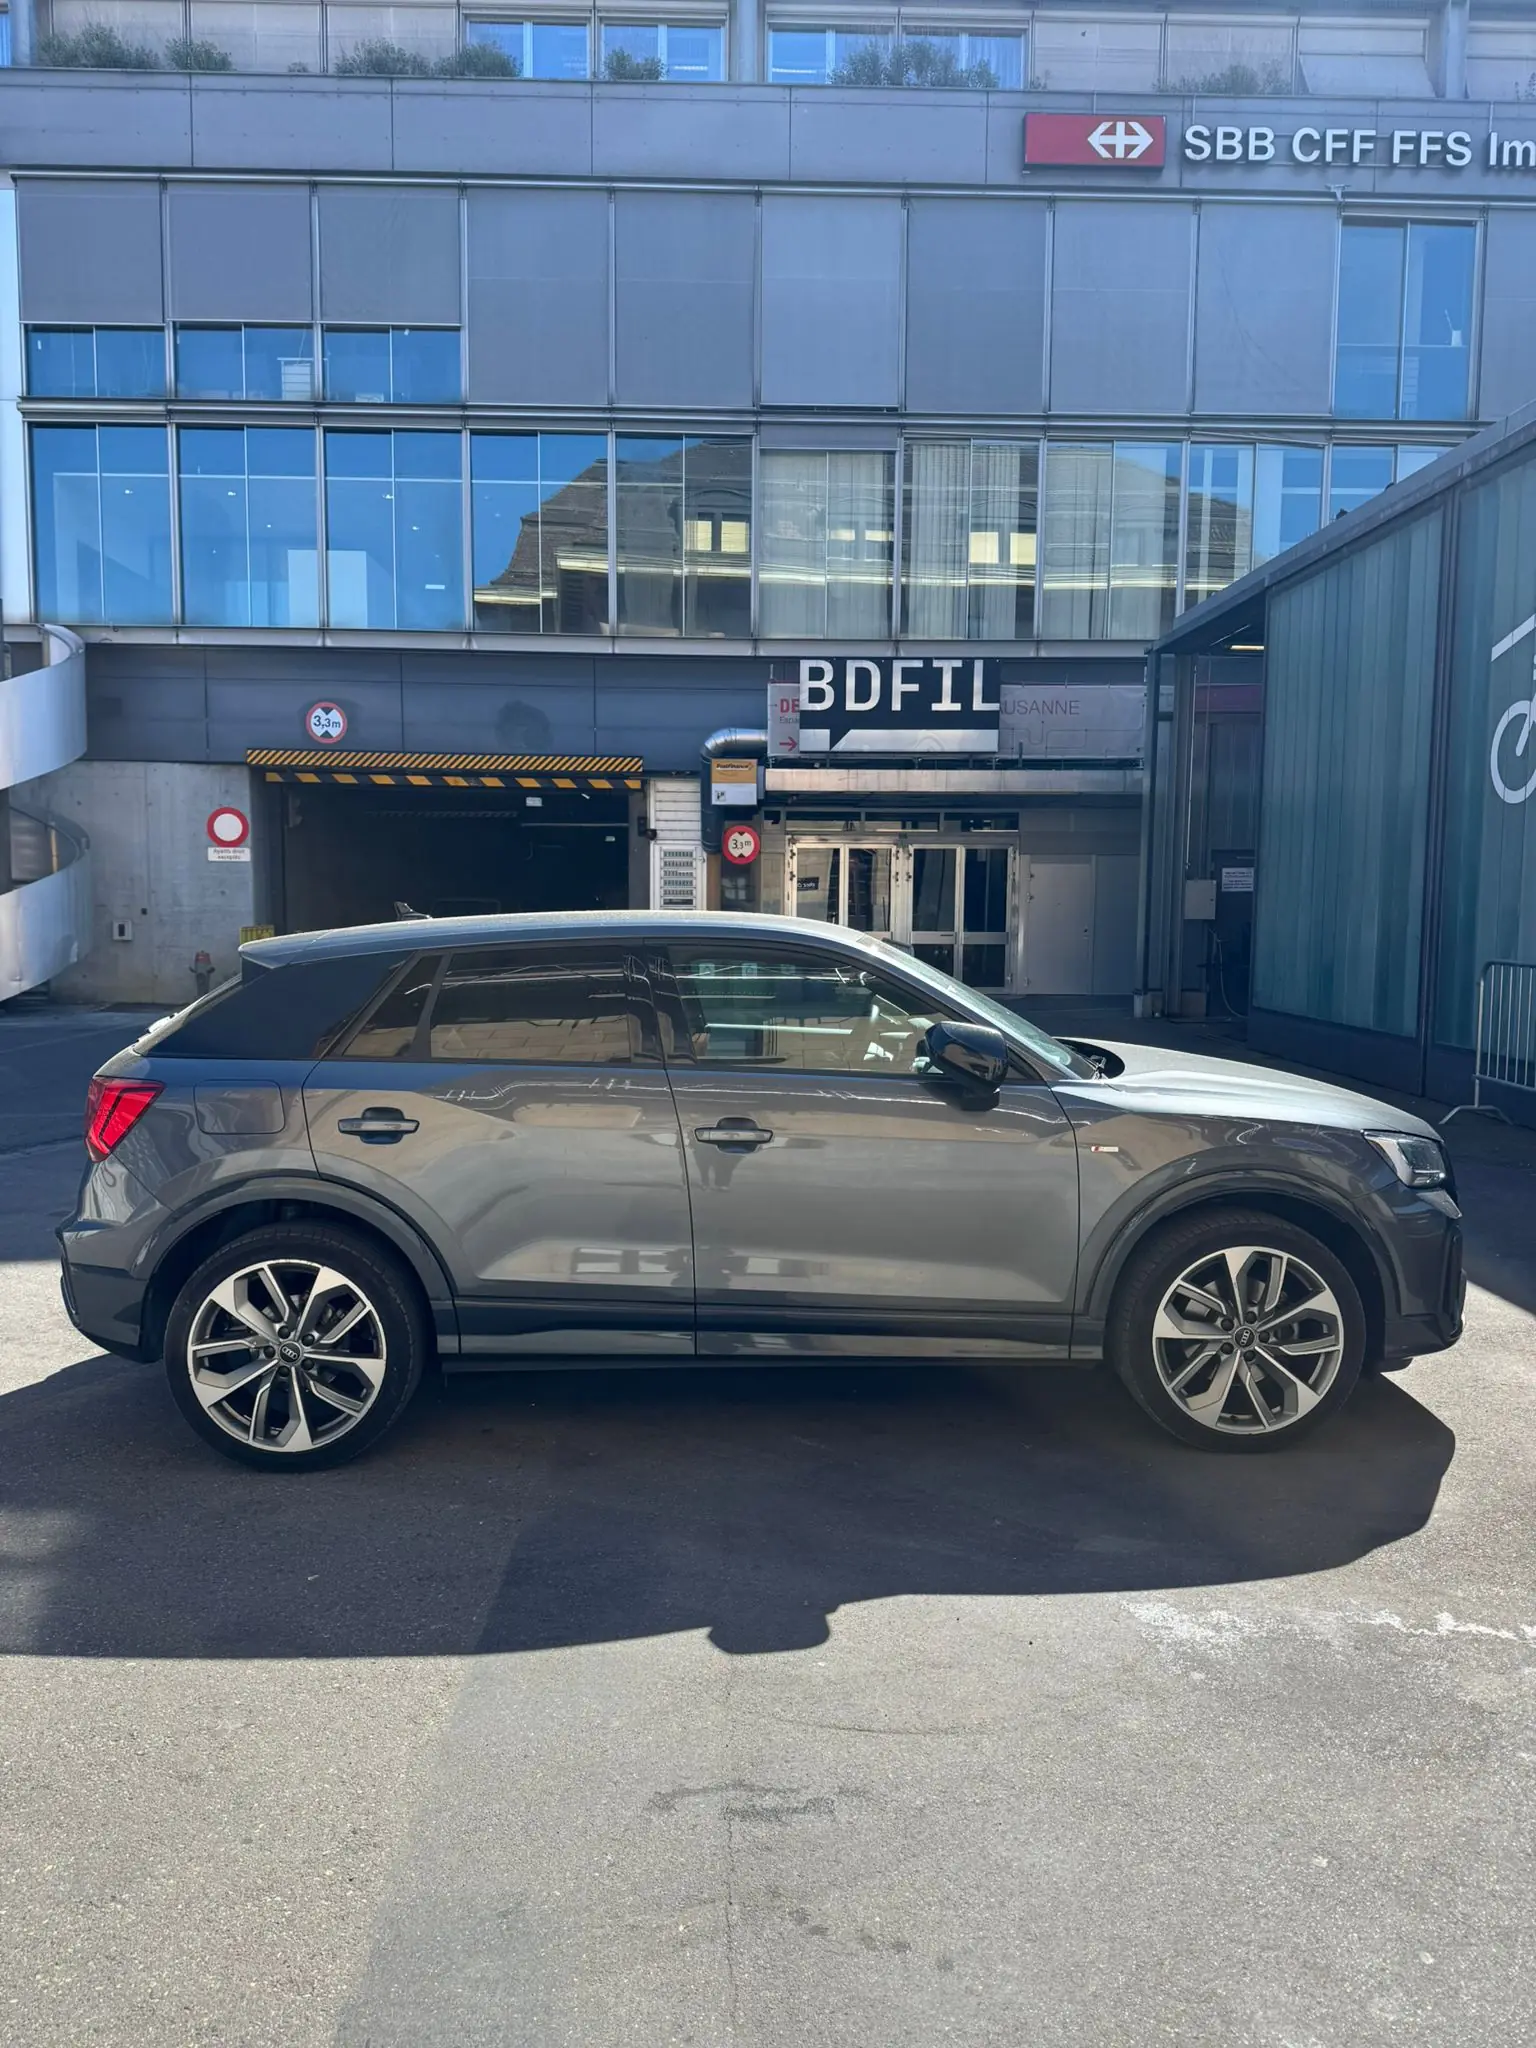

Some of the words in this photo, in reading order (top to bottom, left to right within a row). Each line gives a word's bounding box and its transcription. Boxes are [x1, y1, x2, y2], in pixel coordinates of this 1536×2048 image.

[1184, 124, 1276, 162] SBB
[1292, 127, 1377, 164] CFF
[1392, 129, 1473, 166] FFS
[800, 659, 1000, 712] BDFIL
